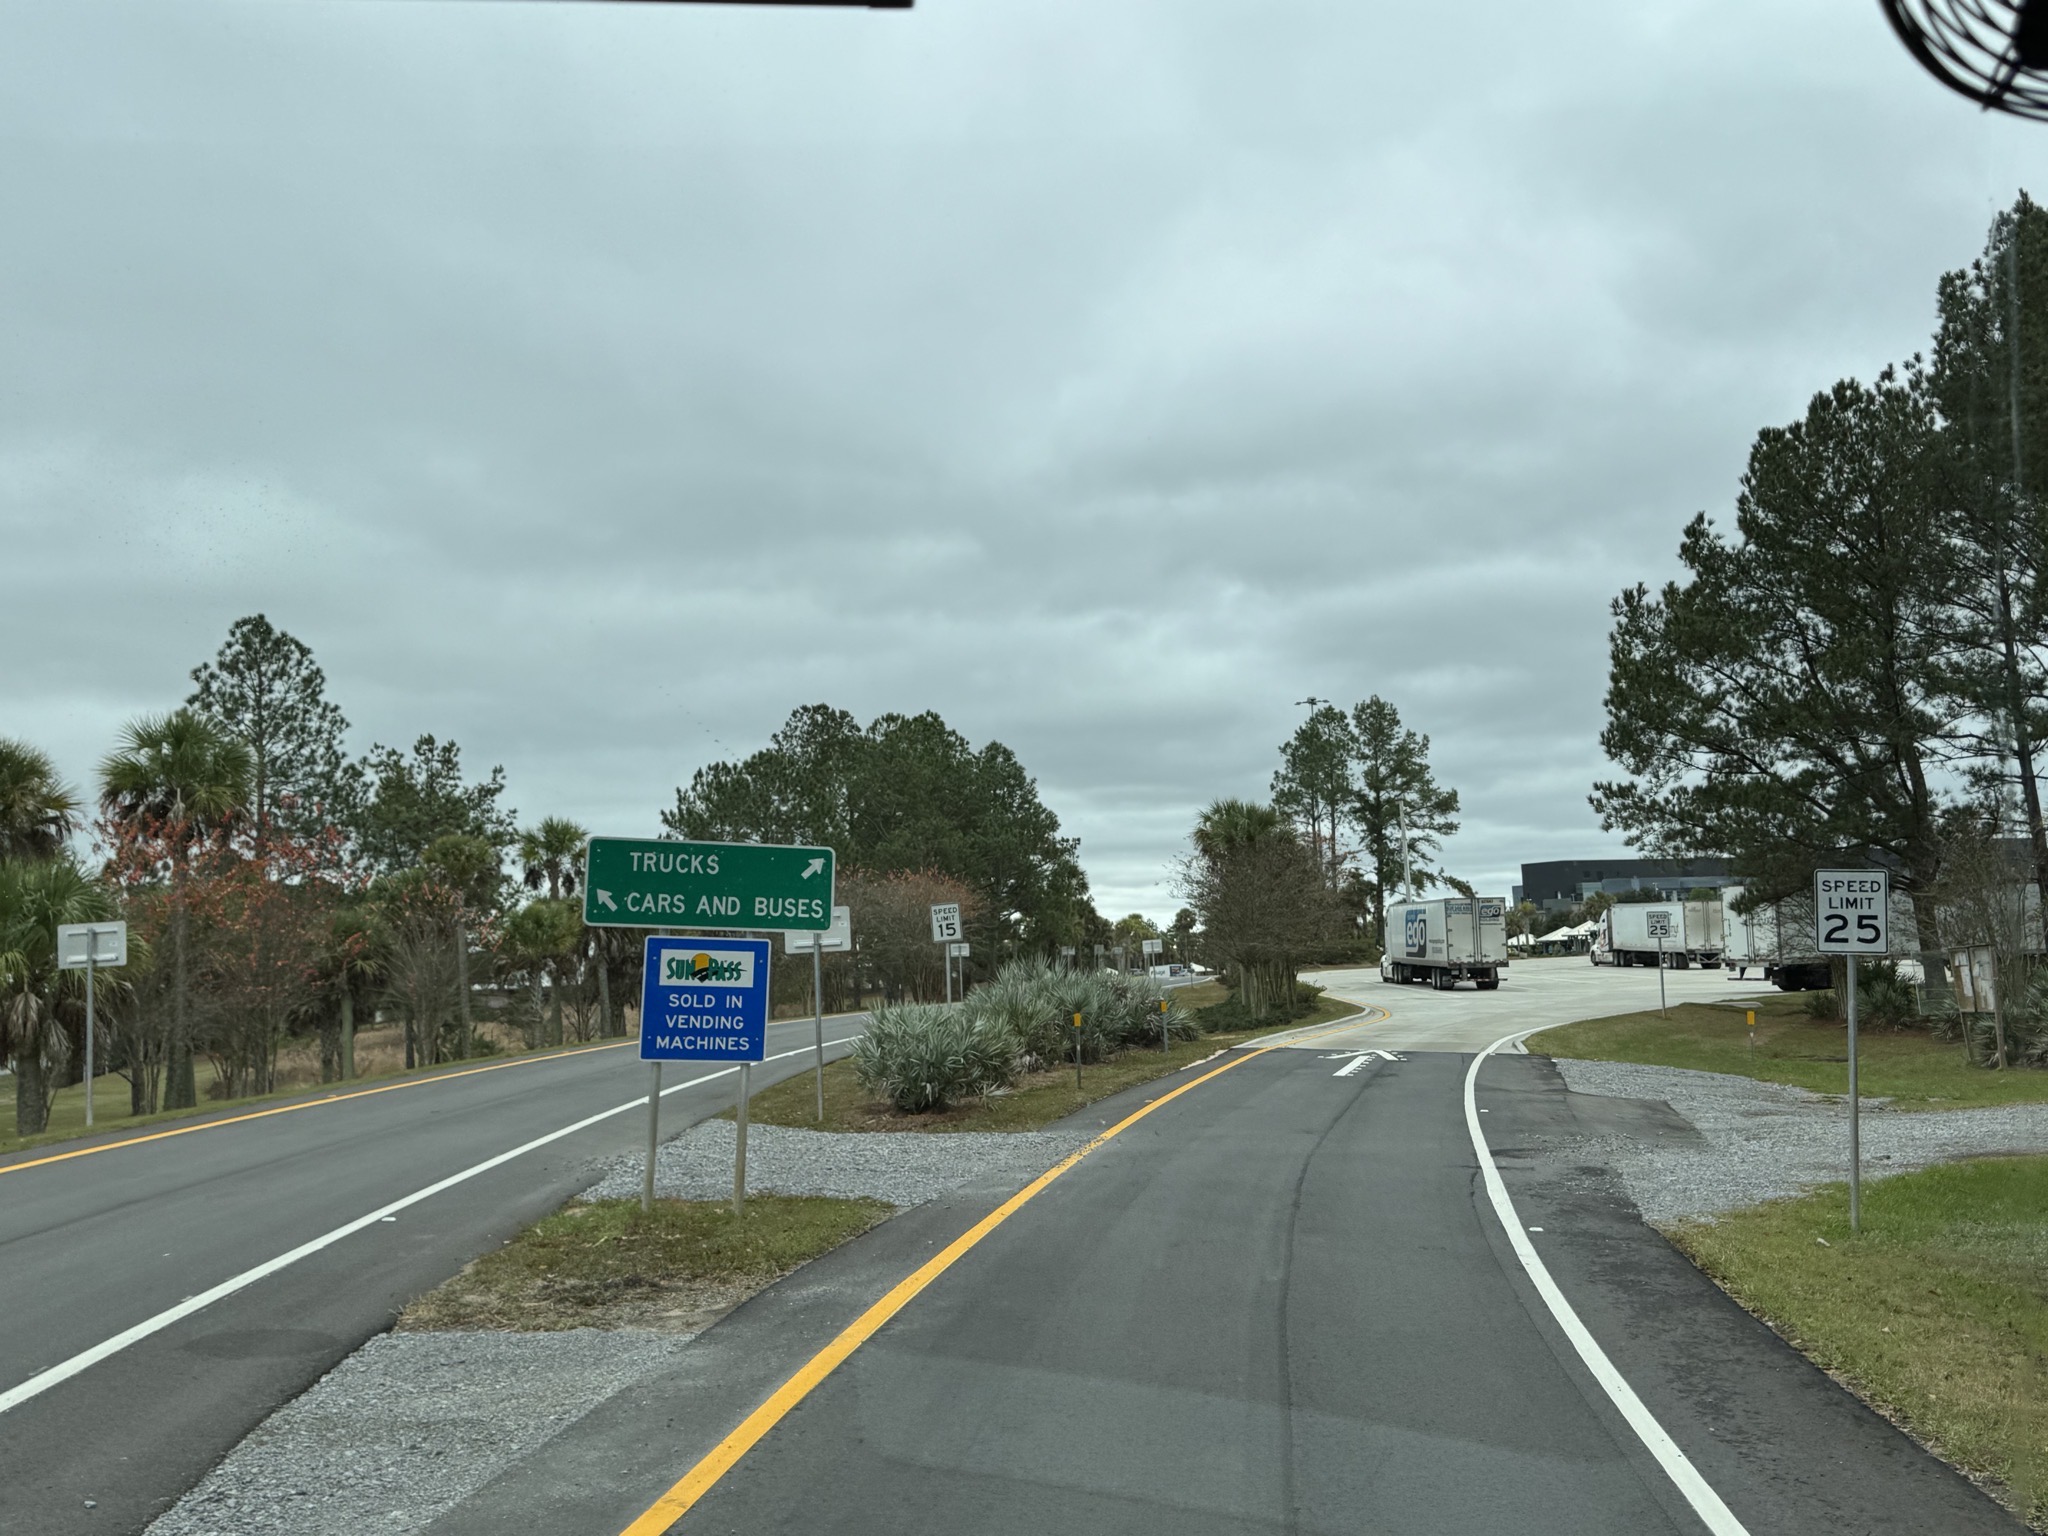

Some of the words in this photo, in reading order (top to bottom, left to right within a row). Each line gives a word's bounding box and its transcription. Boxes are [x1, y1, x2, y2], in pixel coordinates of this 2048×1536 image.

[630, 852, 720, 875] TRUCKS
[1822, 880, 1881, 892] SPEED
[626, 892, 686, 914] CARS
[695, 895, 741, 916] AND
[754, 897, 824, 918] BUSES
[1828, 897, 1875, 909] LIMIT
[933, 907, 958, 916] SPEED
[936, 915, 956, 923] LIMIT
[938, 923, 957, 938] 15
[1650, 925, 1668, 936] 25
[1824, 914, 1881, 944] 25
[668, 993, 716, 1008] SOLD
[725, 994, 743, 1009] IN
[665, 1014, 744, 1030] VENDING
[656, 1035, 750, 1051] MACHINES
